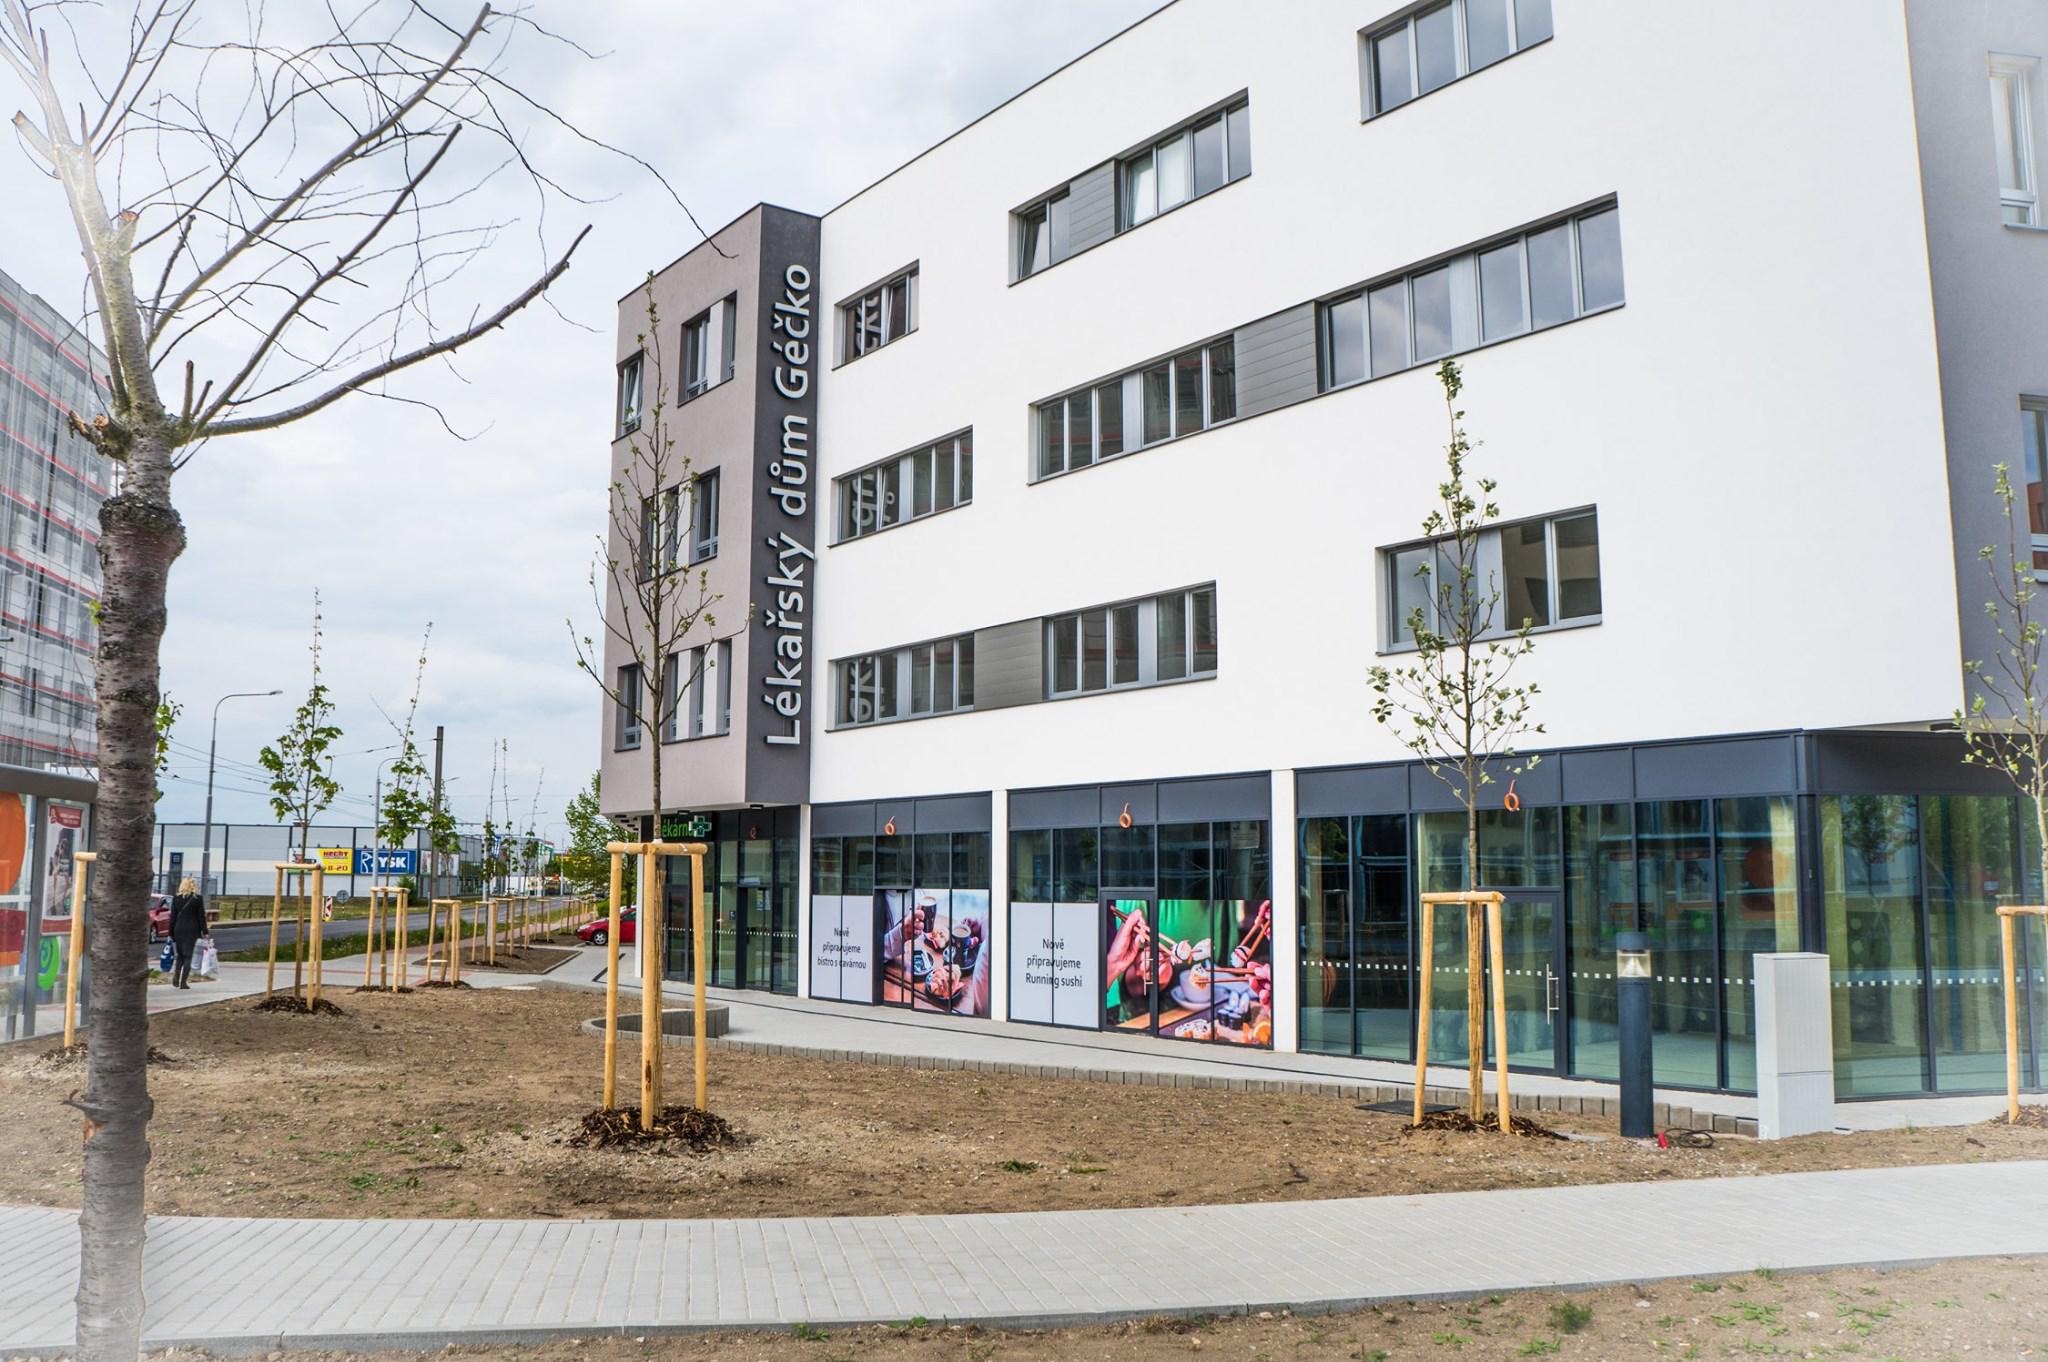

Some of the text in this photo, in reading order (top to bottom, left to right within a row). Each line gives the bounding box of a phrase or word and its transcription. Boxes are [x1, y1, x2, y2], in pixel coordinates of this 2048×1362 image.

[764, 264, 815, 745] Lékařský dům Géčko
[662, 818, 694, 837] ékárn
[371, 856, 406, 868] YSK
[1025, 971, 1082, 989] Running sushi
